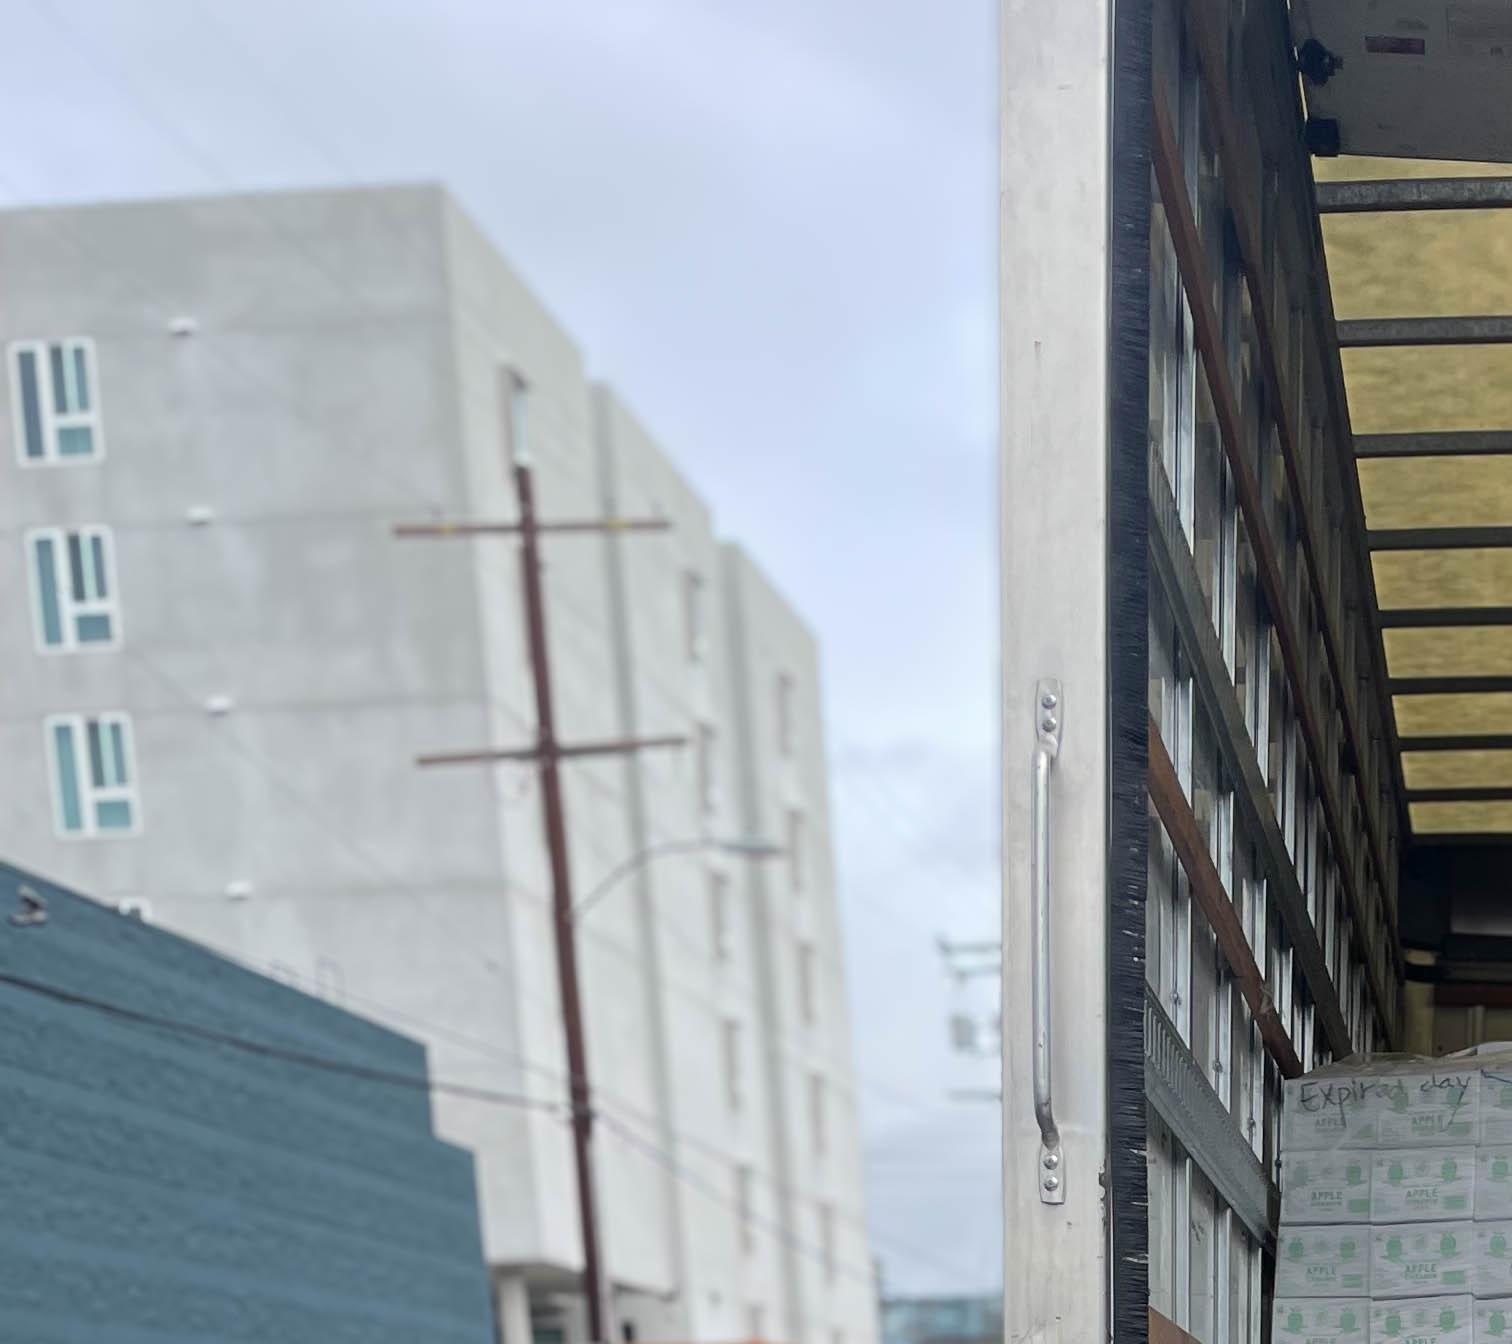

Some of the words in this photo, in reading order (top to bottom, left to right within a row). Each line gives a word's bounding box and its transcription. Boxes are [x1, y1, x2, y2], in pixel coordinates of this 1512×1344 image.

[1420, 1074, 1471, 1133] day
[1311, 1191, 1344, 1201] APPLE
[1406, 1264, 1437, 1274] APPLE
